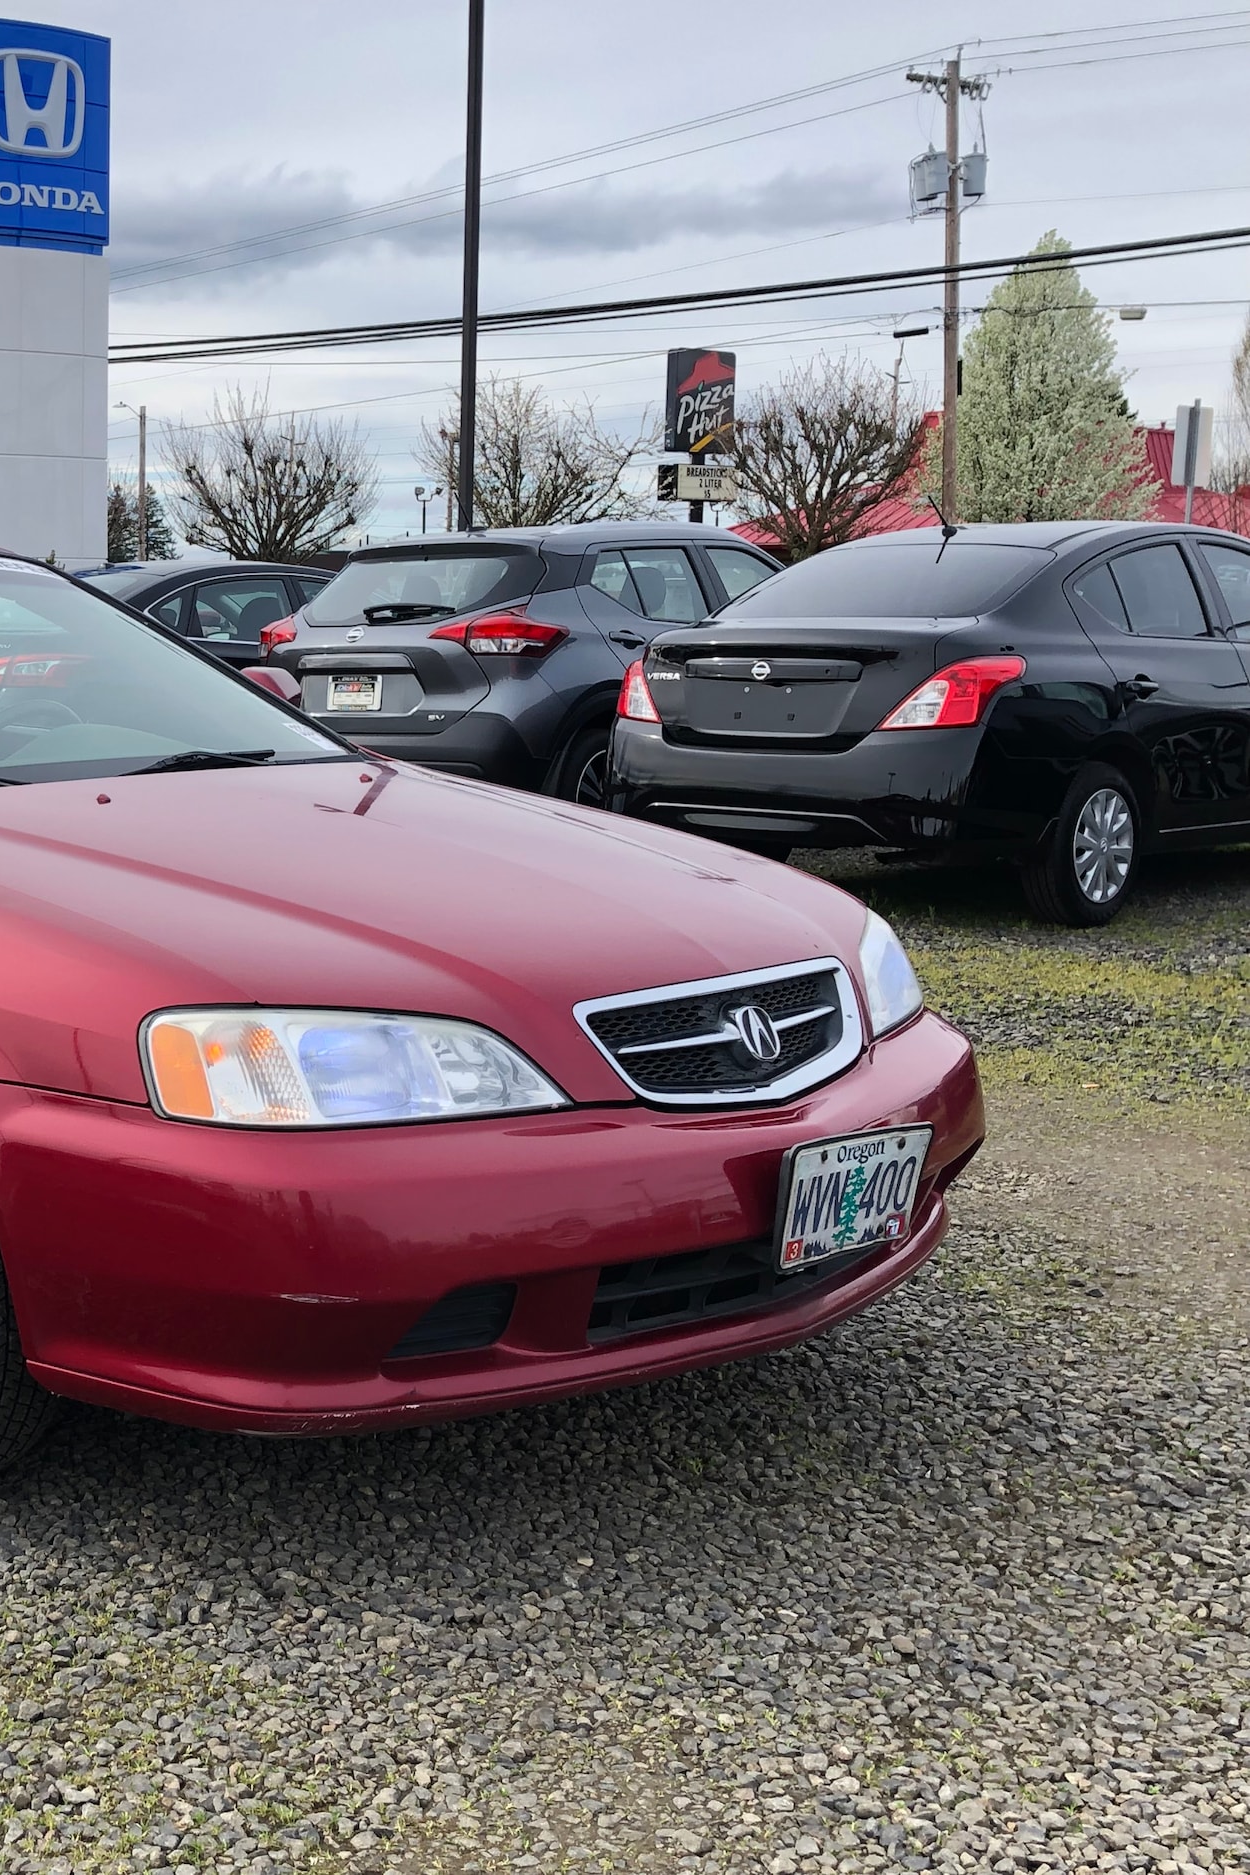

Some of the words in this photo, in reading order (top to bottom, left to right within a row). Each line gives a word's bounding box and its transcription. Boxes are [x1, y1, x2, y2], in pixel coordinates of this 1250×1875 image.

[677, 382, 735, 435] Pizza
[687, 405, 730, 444] Hut
[699, 478, 703, 488] 2
[704, 479, 722, 488] LITER
[647, 672, 681, 681] VERSA
[836, 1140, 886, 1164] Oregon
[790, 1169, 852, 1239] WVN
[859, 1156, 917, 1219] 400
[790, 1242, 799, 1259] 3
